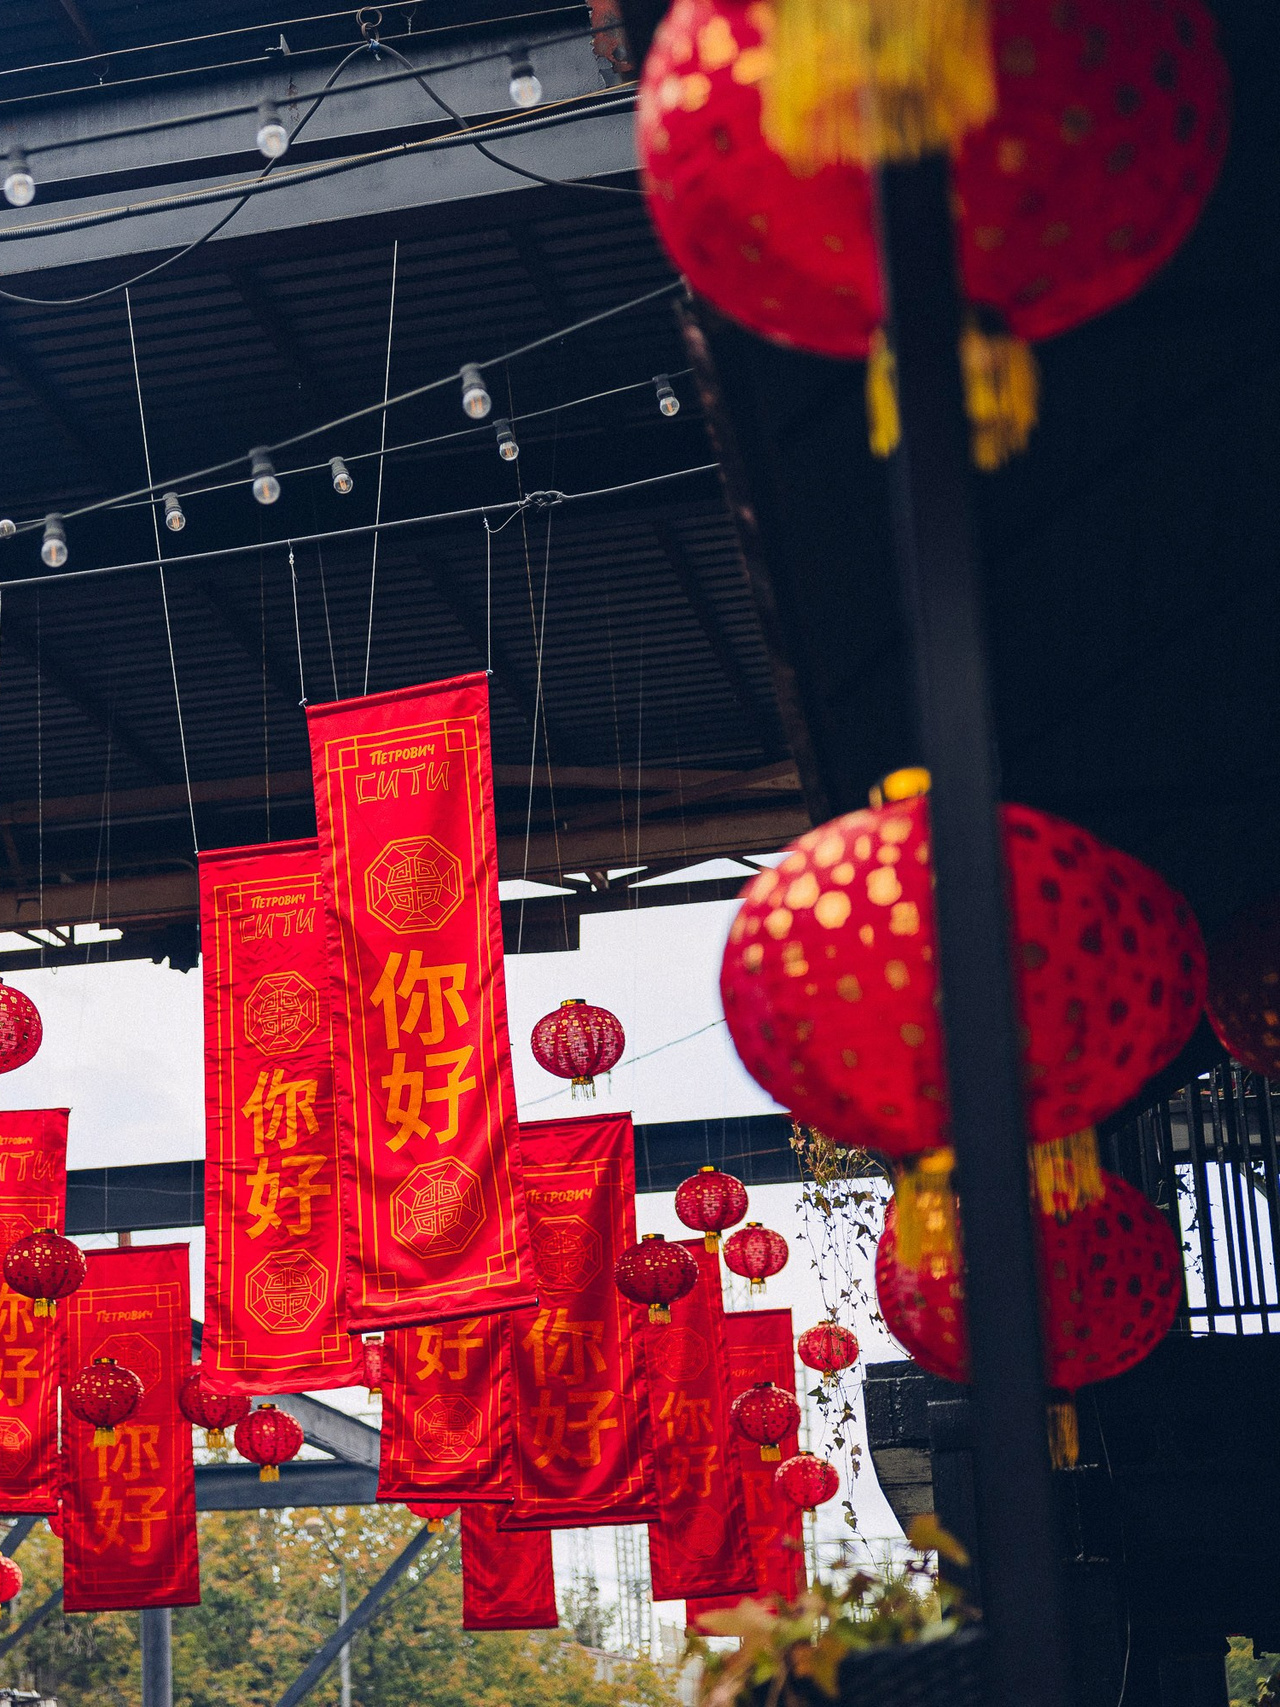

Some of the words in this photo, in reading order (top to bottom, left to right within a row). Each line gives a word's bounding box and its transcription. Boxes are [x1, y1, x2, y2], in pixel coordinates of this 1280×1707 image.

[355, 761, 450, 805] СИТИ
[369, 744, 435, 766] ПЕТРОВИЧ
[240, 907, 316, 943] СИТИ
[251, 893, 306, 909] ПЕТРОВИЧ
[369, 950, 477, 1153] 你好
[241, 1069, 332, 1240] 你好
[521, 1308, 619, 1469] 你好
[87, 1421, 169, 1555] 你好
[658, 1391, 720, 1499] 你好
